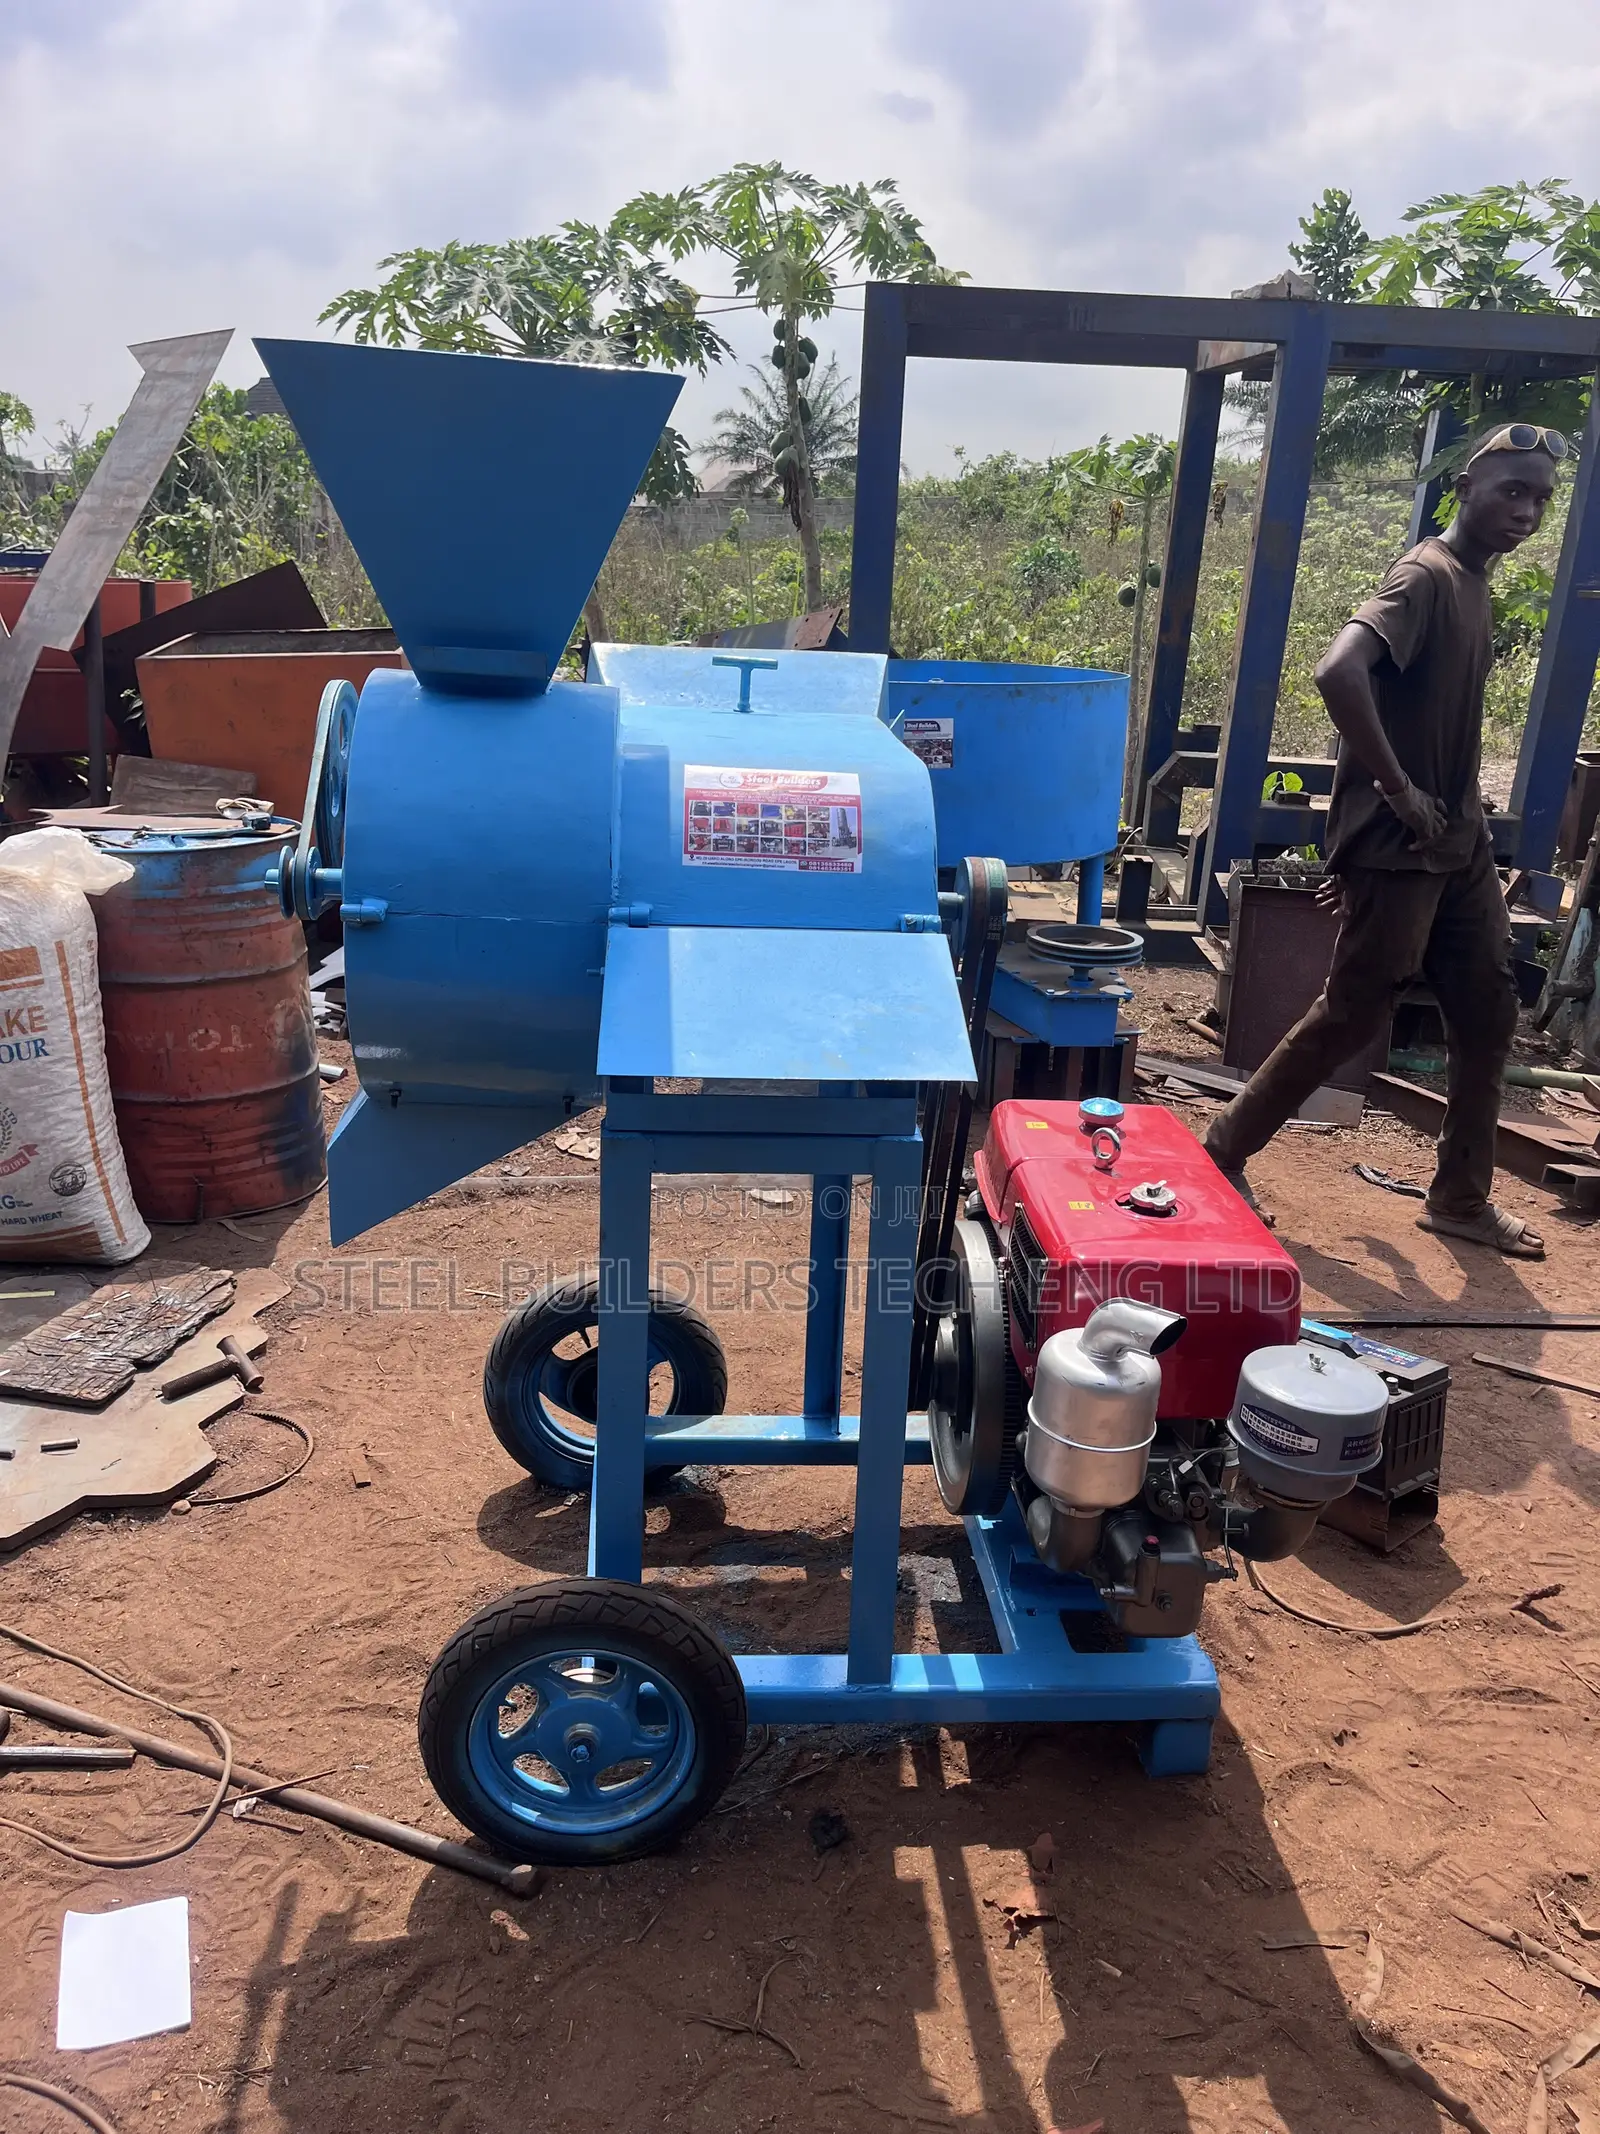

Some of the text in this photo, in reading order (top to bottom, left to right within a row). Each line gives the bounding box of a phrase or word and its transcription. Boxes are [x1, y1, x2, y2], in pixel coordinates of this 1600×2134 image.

[746, 774, 774, 784] Steel
[776, 775, 821, 786] Builders
[0, 1004, 48, 1038] KE
[3, 1107, 18, 1125] LTD
[0, 1195, 16, 1209] G
[1, 1211, 63, 1225] HARD WHEAT
